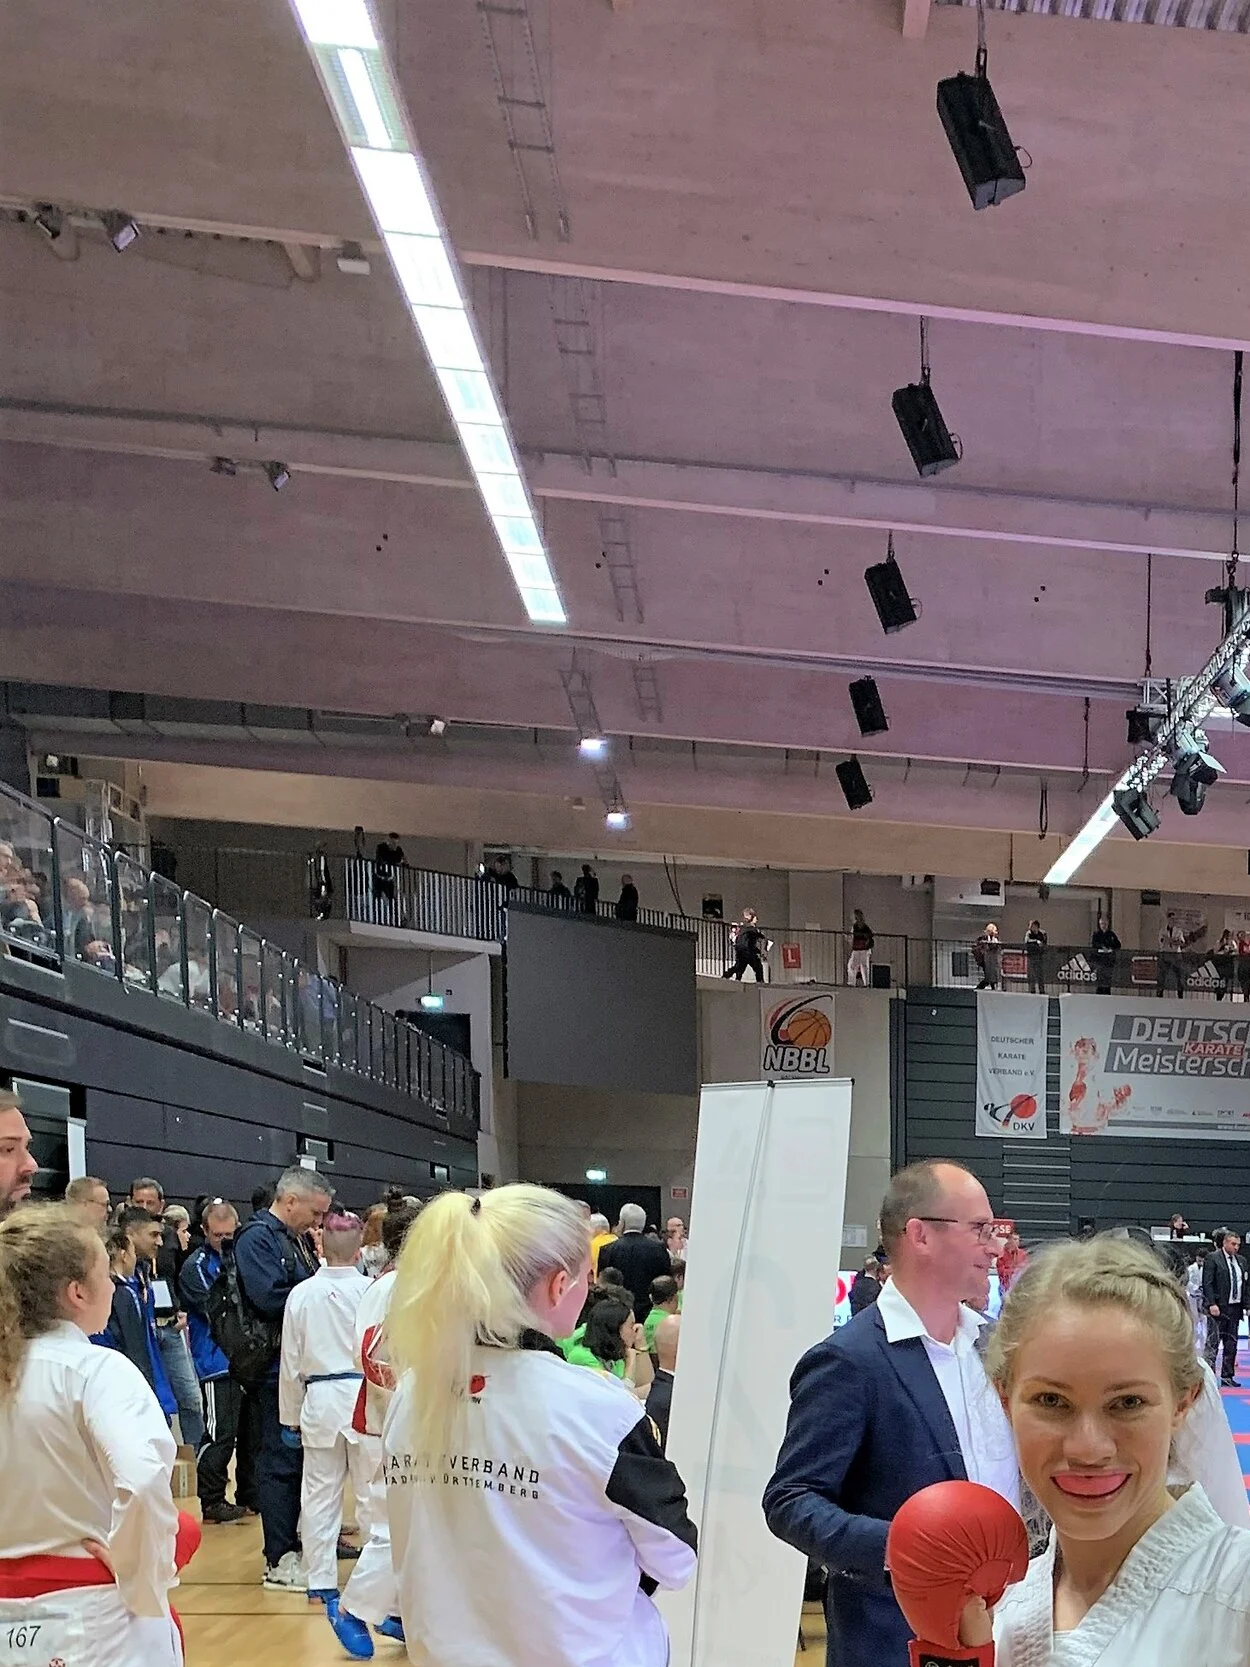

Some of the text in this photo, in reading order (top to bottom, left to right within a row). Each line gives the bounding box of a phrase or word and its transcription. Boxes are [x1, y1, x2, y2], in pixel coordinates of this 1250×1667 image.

[1057, 970, 1098, 982] adidas
[1186, 976, 1226, 989] adidas
[990, 1035, 1035, 1046] DEUTSCHER
[1184, 1041, 1244, 1057] KARATE
[763, 1044, 831, 1074] NBBL
[997, 1052, 1026, 1061] KARATE
[988, 1067, 1023, 1077] VERBAND
[1012, 1121, 1036, 1132] DKV
[7, 1625, 42, 1649] 167
